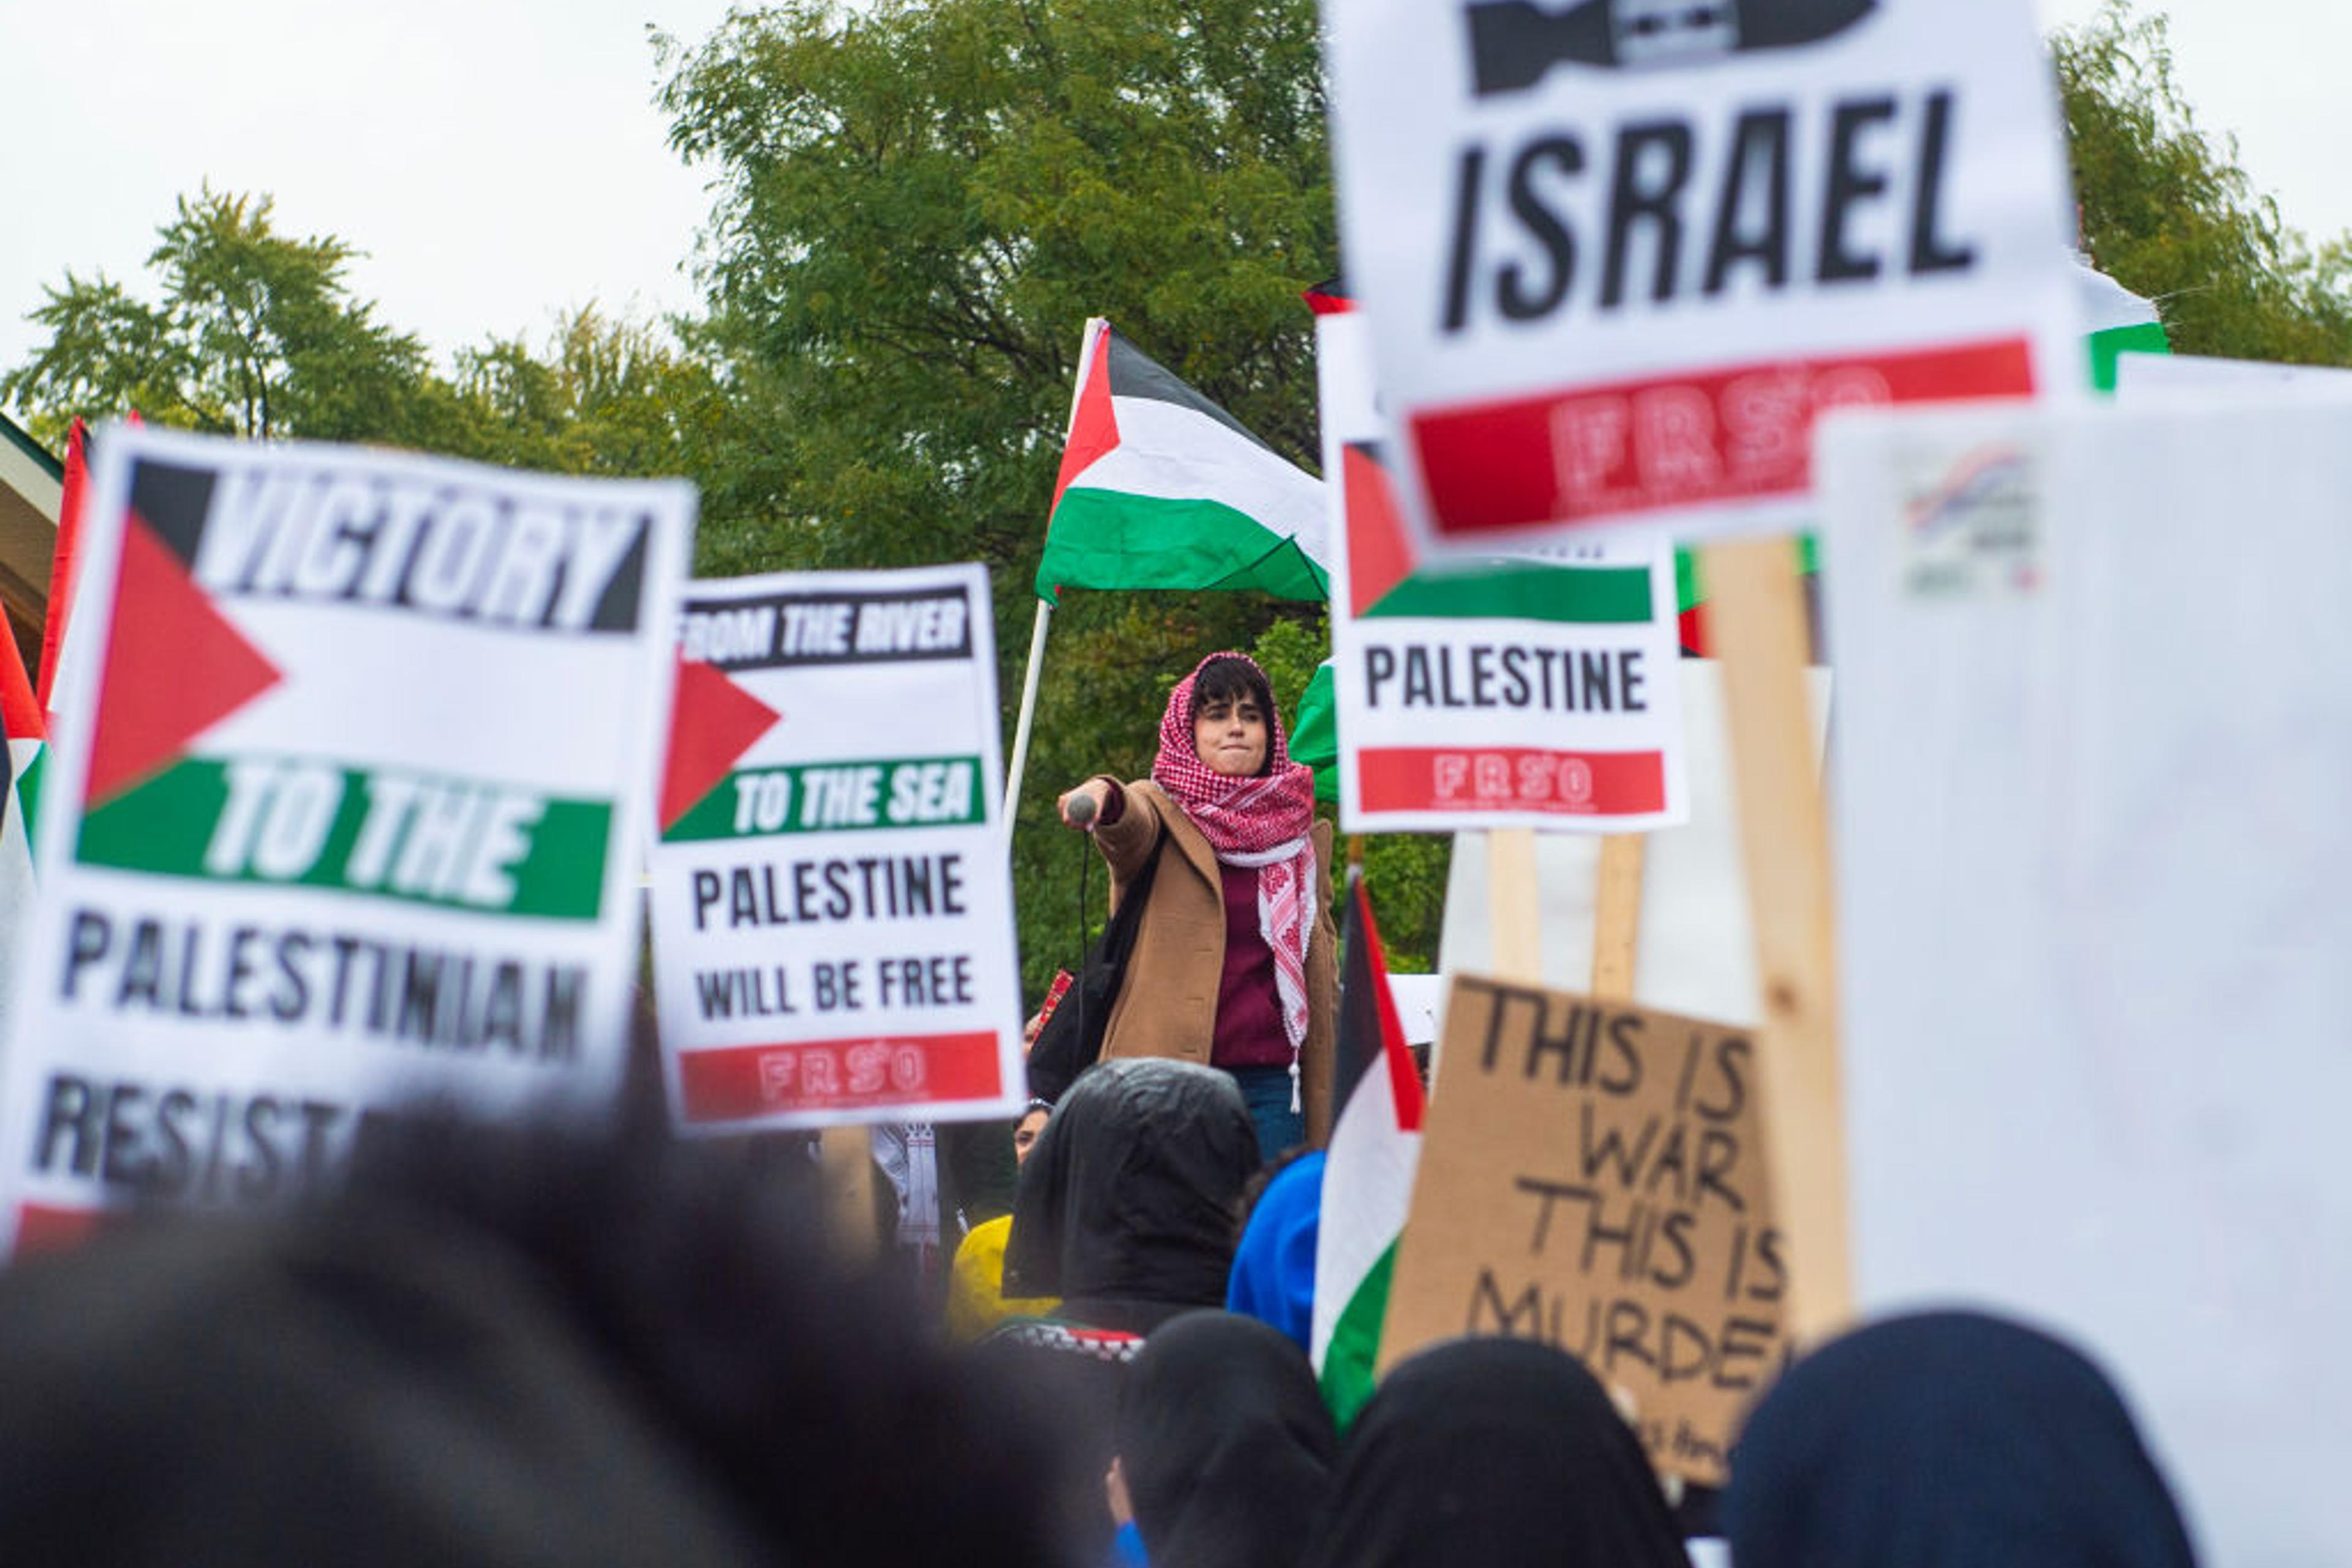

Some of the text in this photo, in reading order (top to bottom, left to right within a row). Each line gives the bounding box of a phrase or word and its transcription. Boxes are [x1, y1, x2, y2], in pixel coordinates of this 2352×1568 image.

[1439, 89, 1976, 334] ISRAEL
[195, 470, 640, 631] VICTORY
[781, 603, 852, 653] THE
[856, 598, 968, 652] RIVER
[1365, 646, 1647, 711] PALESTINE
[733, 761, 973, 834] TO THE SEA
[1433, 753, 1593, 804] FRSO
[202, 763, 545, 905] TO THE
[694, 854, 966, 930] PALESTINE
[60, 910, 587, 1063] PALESTINIAN
[696, 955, 973, 1020] WILL BE FREE
[758, 1040, 925, 1099] FRSO
[1455, 978, 1752, 1121] THIS IS
[1580, 1103, 1745, 1213] WAR
[1515, 1176, 1788, 1303] THIS IS
[1468, 1265, 1793, 1389] MURDE
